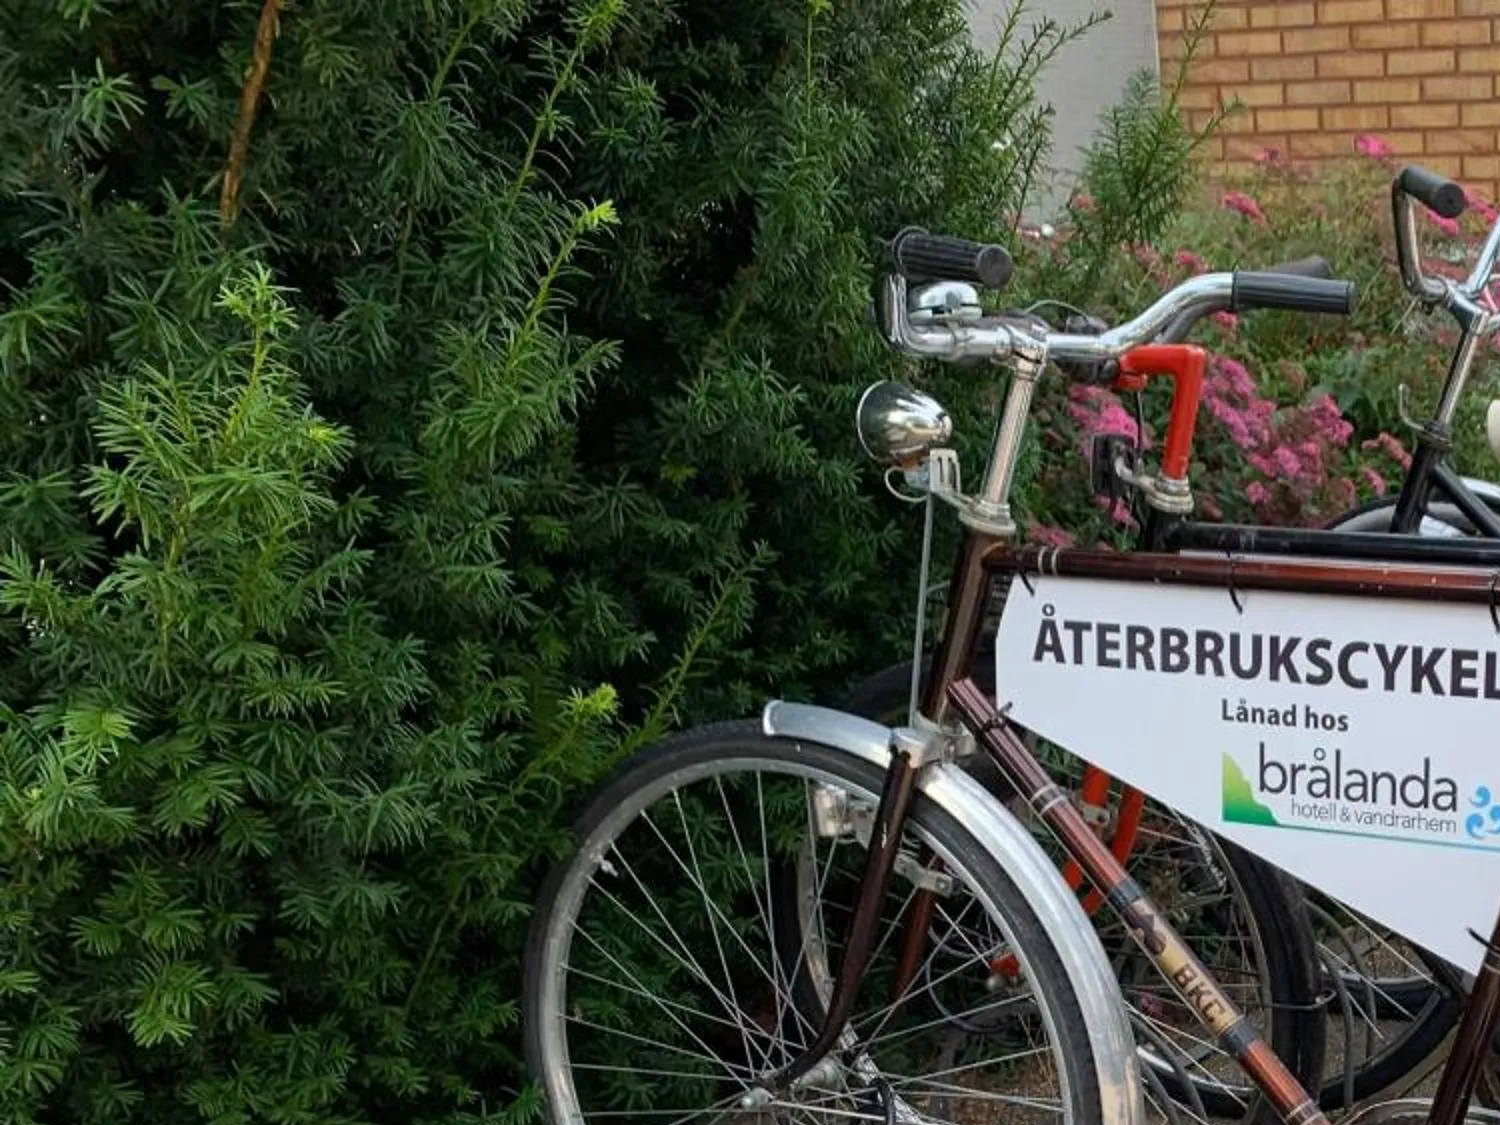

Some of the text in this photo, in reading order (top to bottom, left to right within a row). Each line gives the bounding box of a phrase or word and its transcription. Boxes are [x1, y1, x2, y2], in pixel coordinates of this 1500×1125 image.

[1221, 699, 1349, 732] Lånad hos
[1258, 741, 1458, 812] brålanda
[1291, 798, 1457, 834] hotell & vandrarhem
